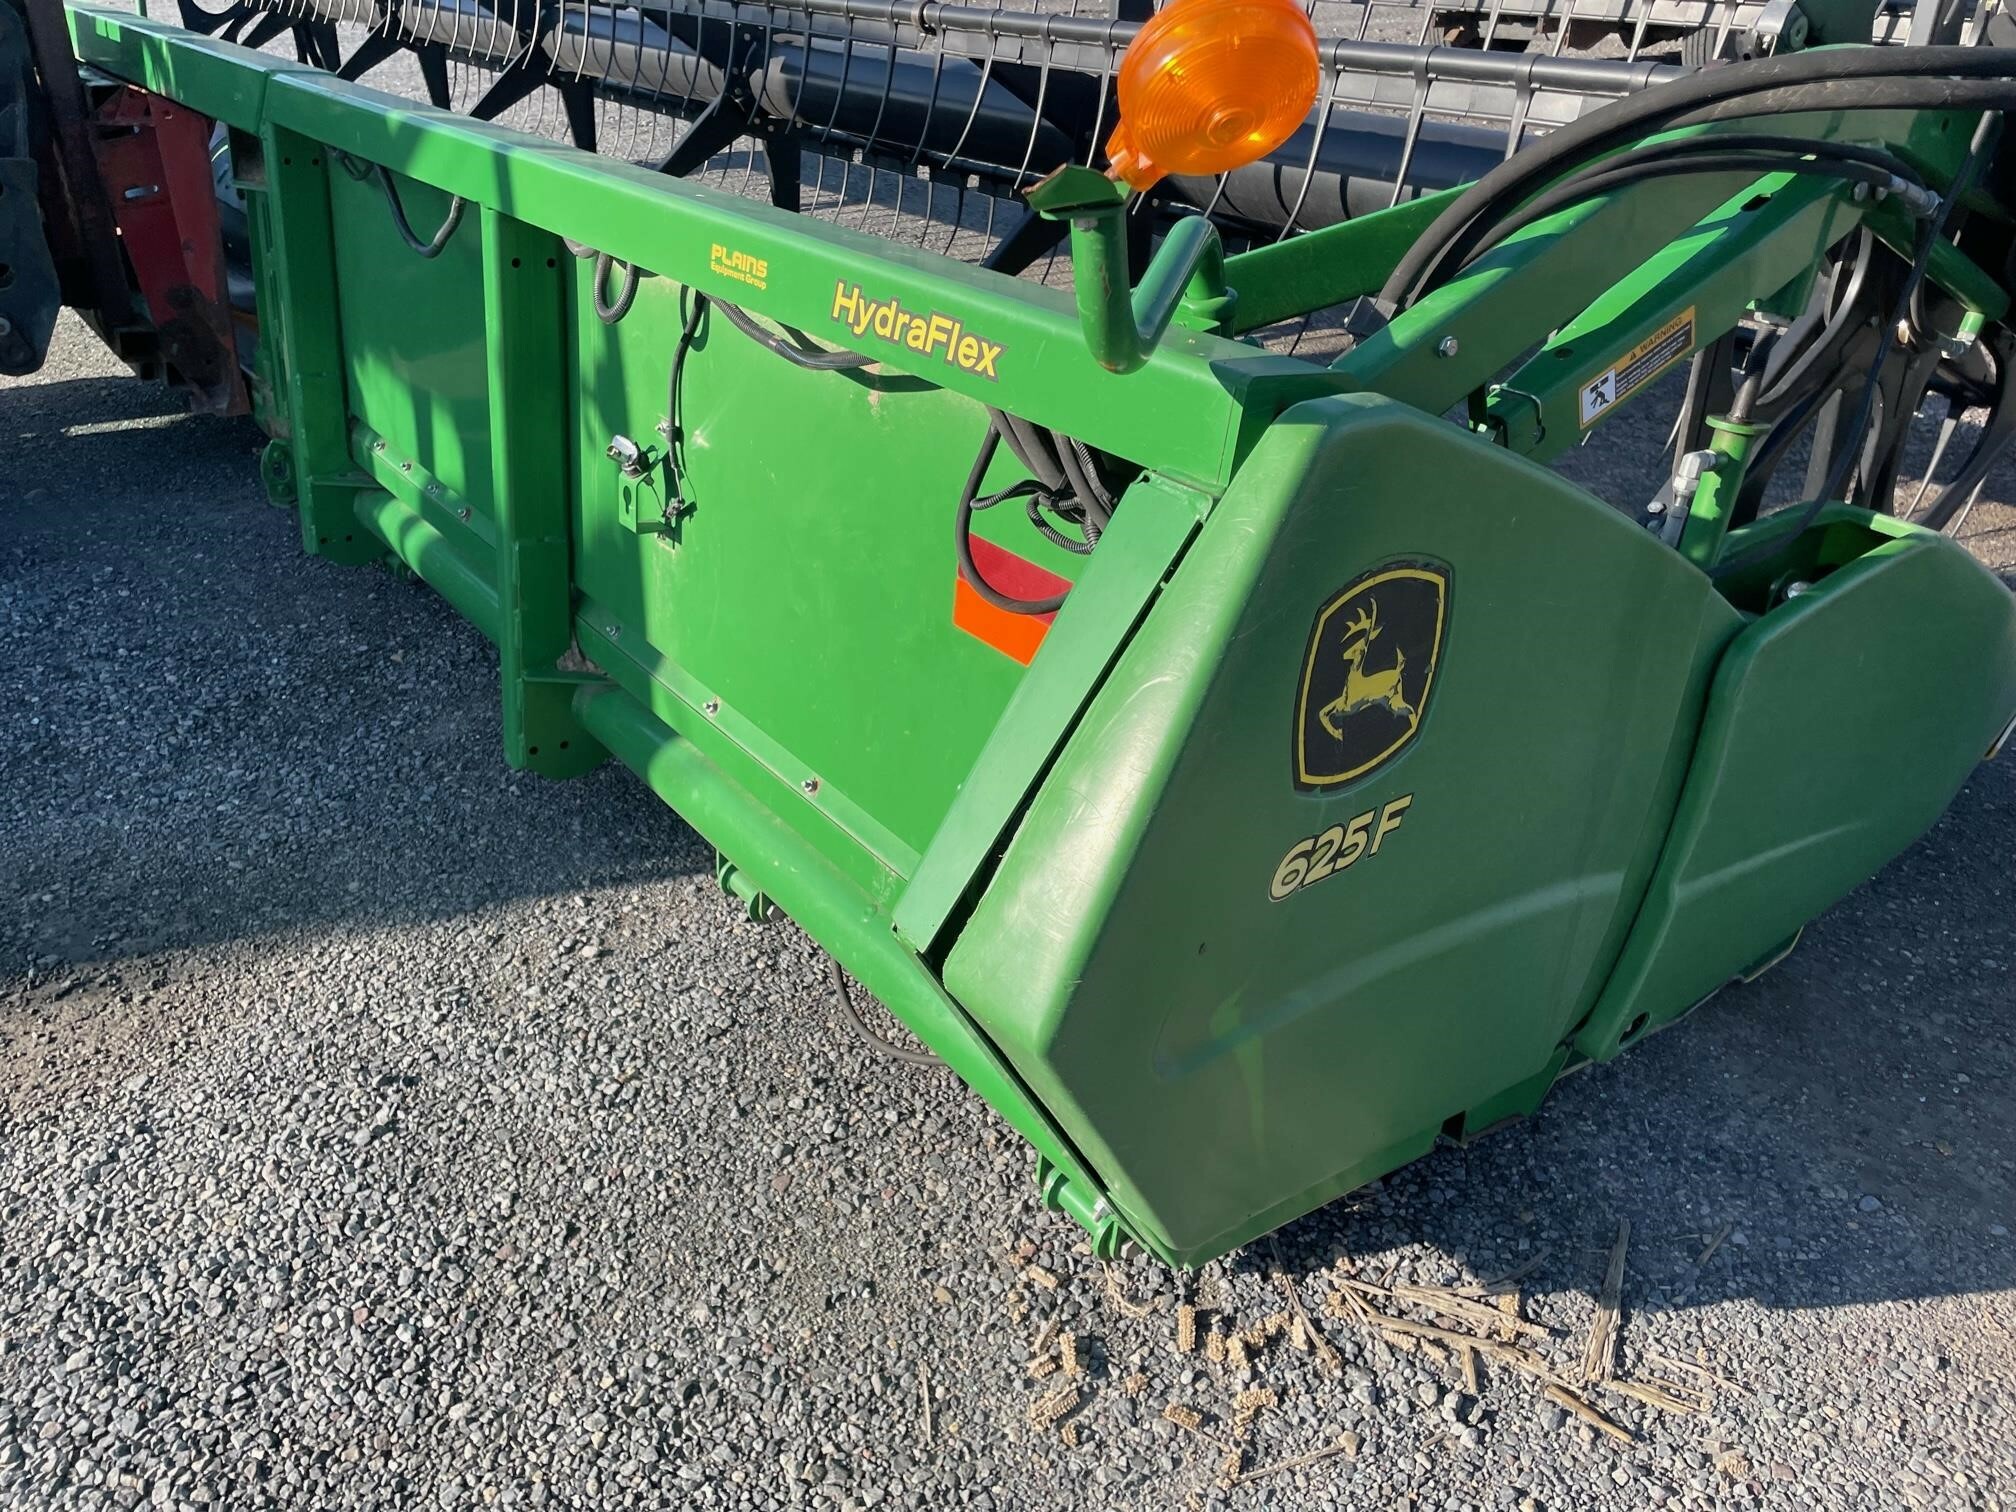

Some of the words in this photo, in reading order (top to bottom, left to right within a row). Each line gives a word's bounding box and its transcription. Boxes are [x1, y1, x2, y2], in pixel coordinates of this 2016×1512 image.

[711, 244, 768, 278] PLAINS
[711, 261, 745, 282] Equipment
[745, 273, 767, 290] Group
[831, 280, 1002, 380] HydraFlex
[1639, 317, 1682, 351] WARNING
[1268, 793, 1413, 900] 625F
